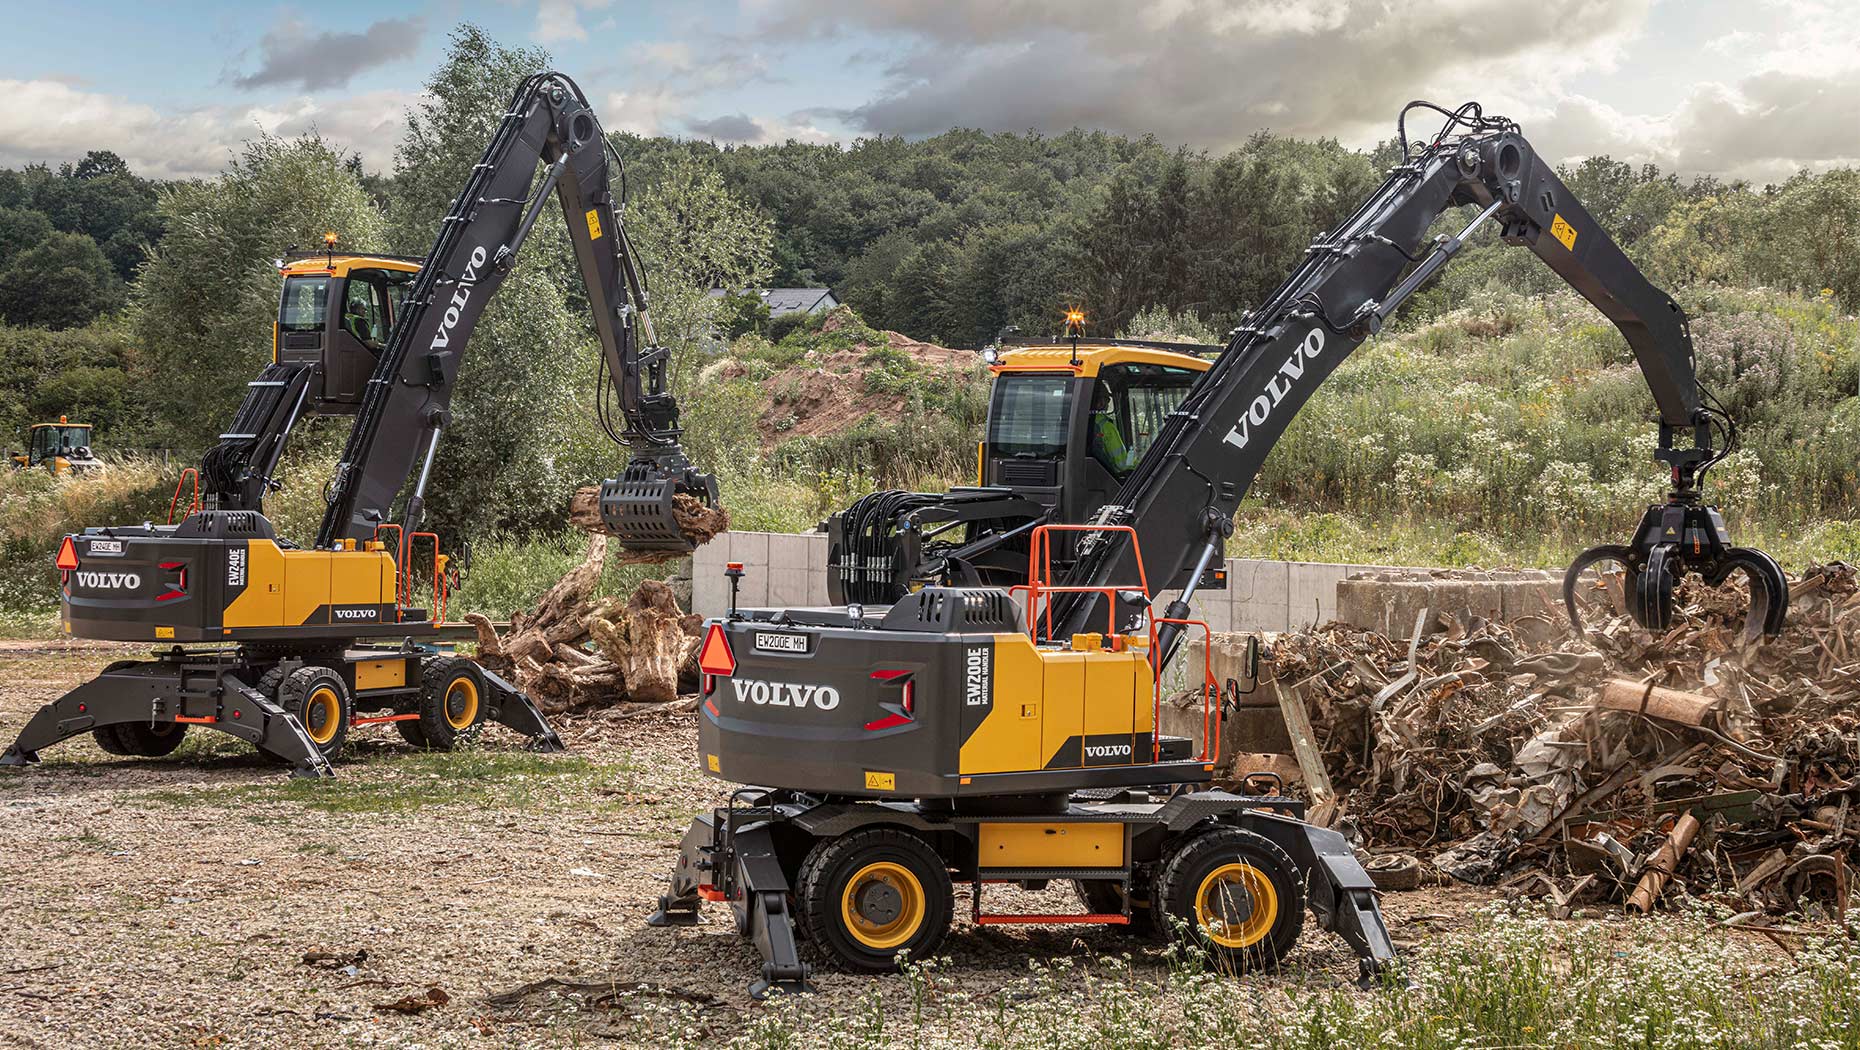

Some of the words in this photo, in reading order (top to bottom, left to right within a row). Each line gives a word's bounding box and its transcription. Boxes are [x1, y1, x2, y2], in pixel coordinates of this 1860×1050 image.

[430, 246, 487, 350] VOLVO
[1222, 327, 1325, 449] VOLVO
[76, 571, 141, 590] VOLVO
[228, 549, 240, 586] EW240E
[335, 609, 377, 619] VOLVO
[757, 634, 790, 649] EW200E
[793, 638, 805, 651] MH
[981, 647, 989, 675] HANDLER
[967, 647, 982, 706] EW200E
[981, 675, 989, 705] MATERIAL
[731, 678, 840, 711] VOLVO
[1085, 744, 1132, 758] VOLVO
